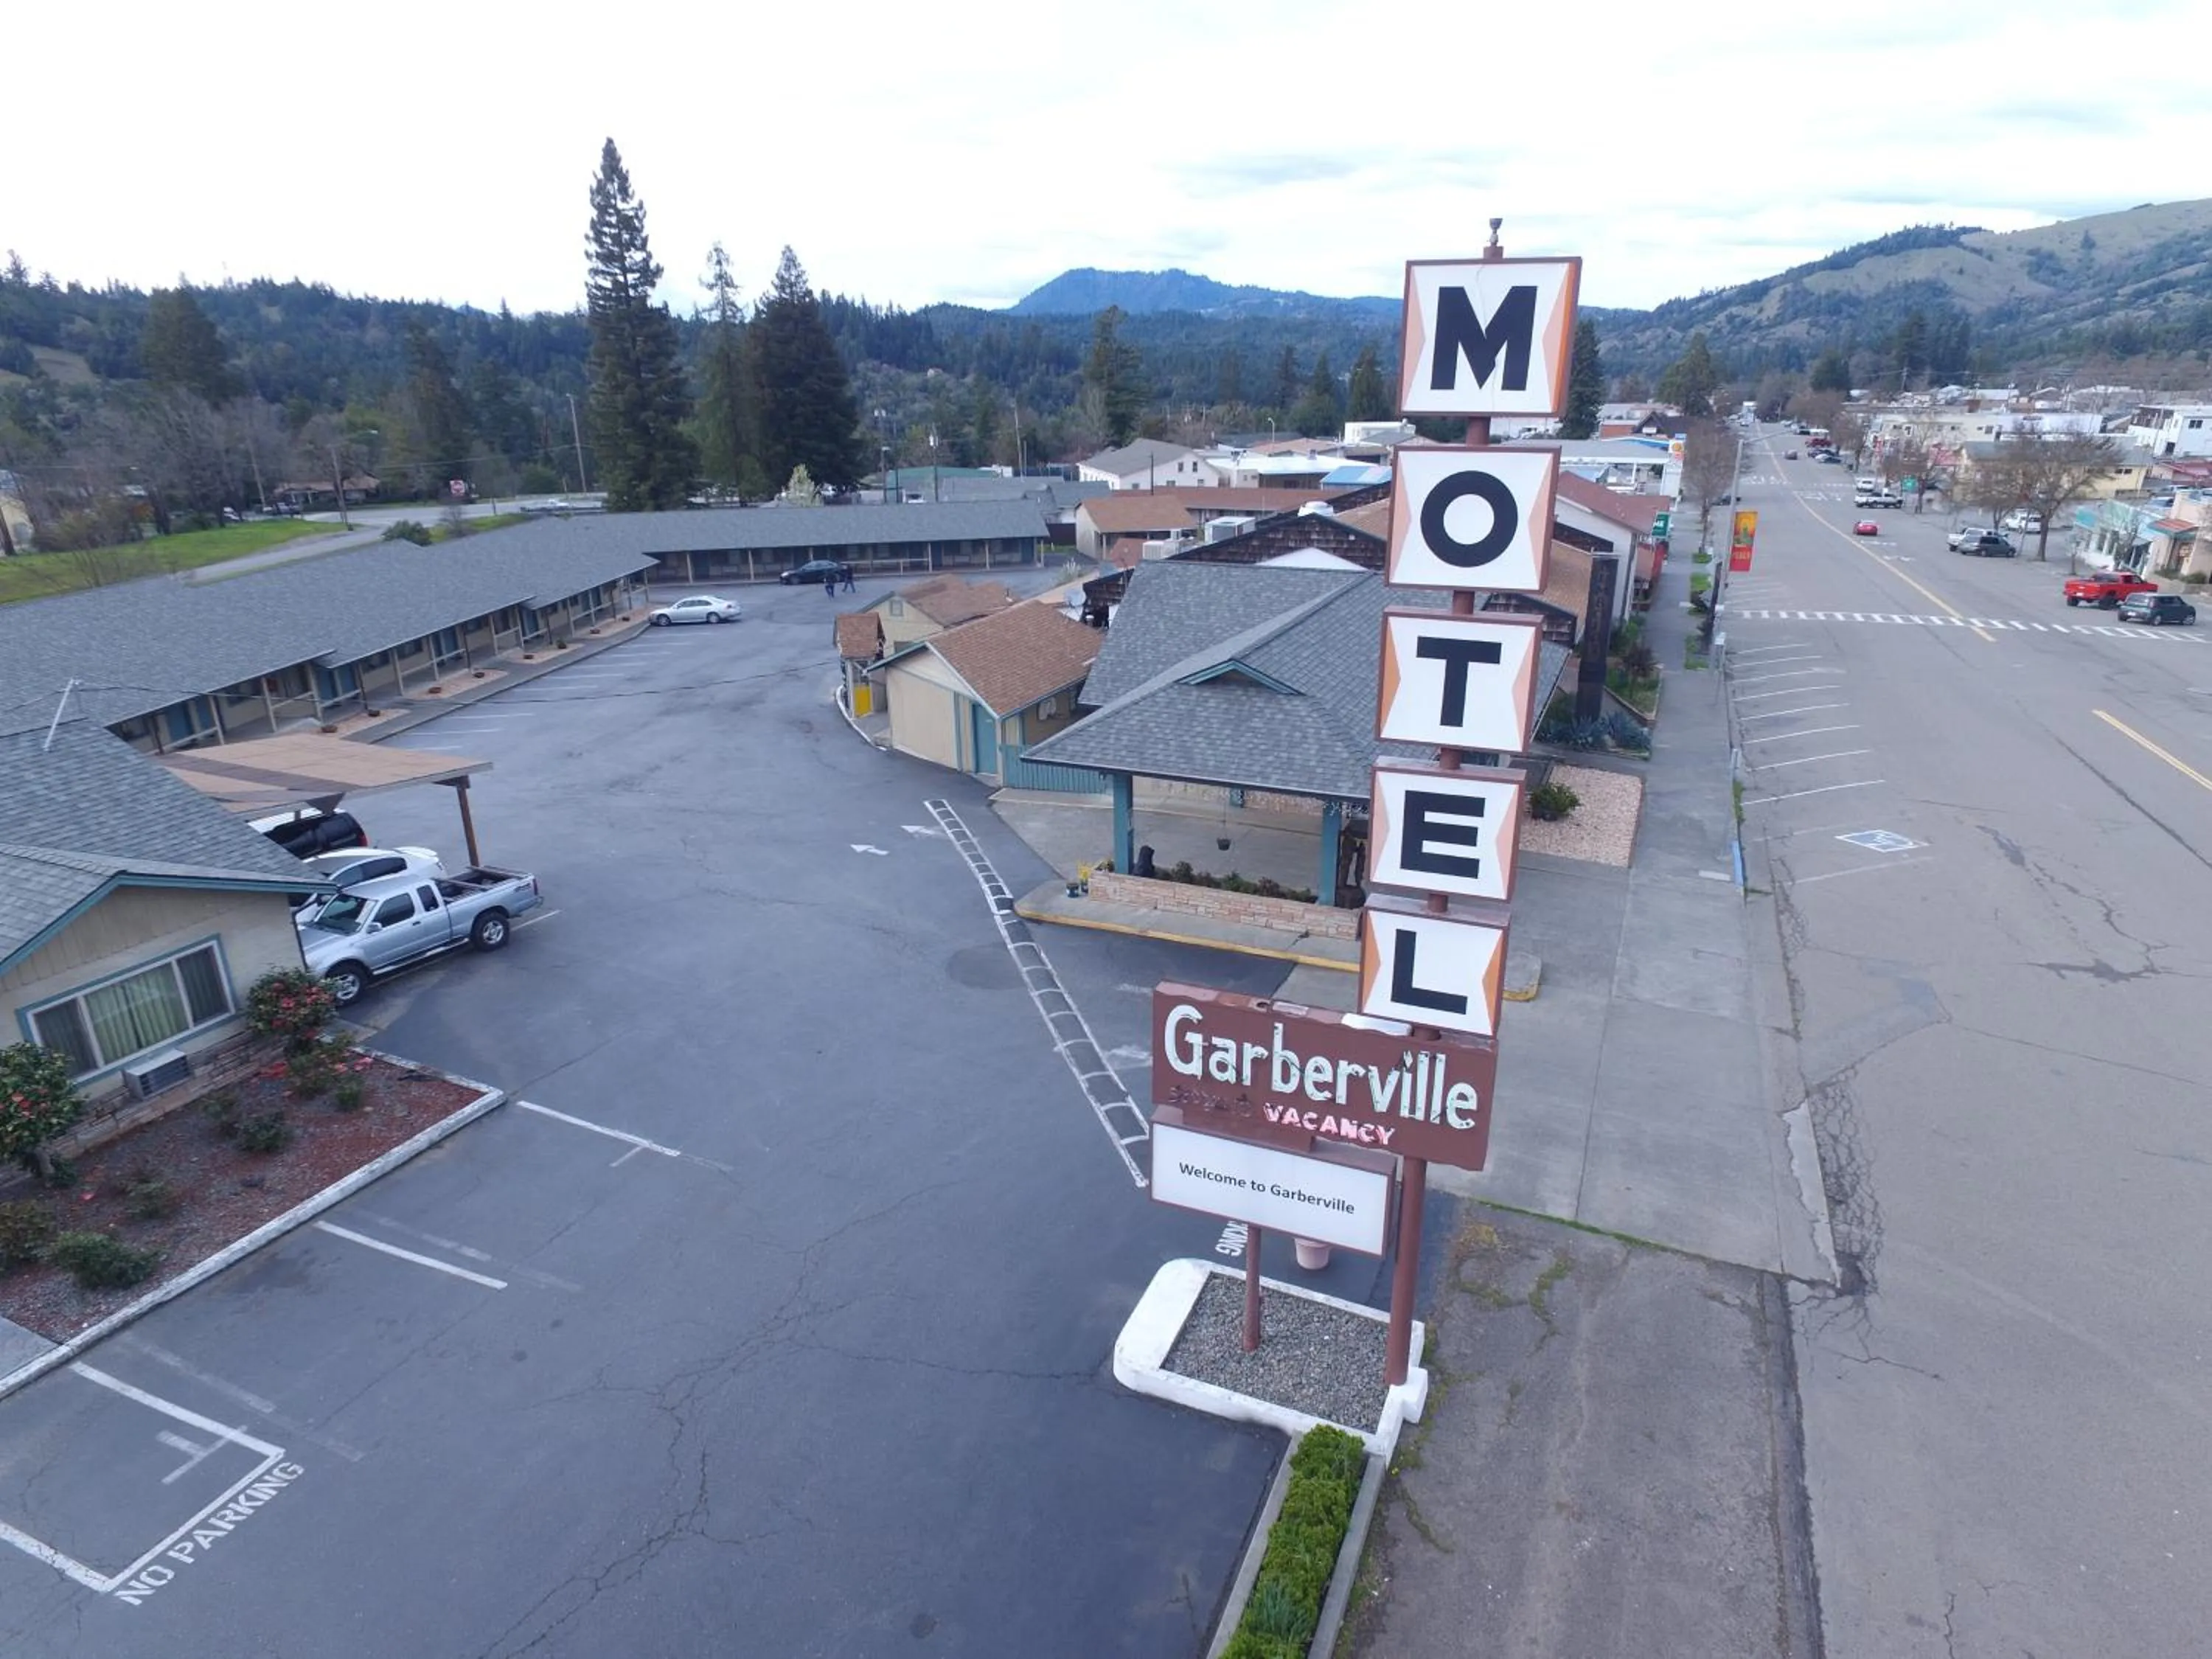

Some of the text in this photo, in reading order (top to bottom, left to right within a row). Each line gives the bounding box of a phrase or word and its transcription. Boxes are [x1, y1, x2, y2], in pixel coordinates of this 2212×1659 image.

[1391, 285, 1538, 1015] MOTEL
[1164, 1004, 1478, 1130] Garberville
[1263, 1102, 1396, 1146] VACANCY
[1179, 1162, 1355, 1215] Welcome to Garberville
[1214, 1220, 1249, 1257] KING
[114, 1461, 305, 1606] NO PARKING
